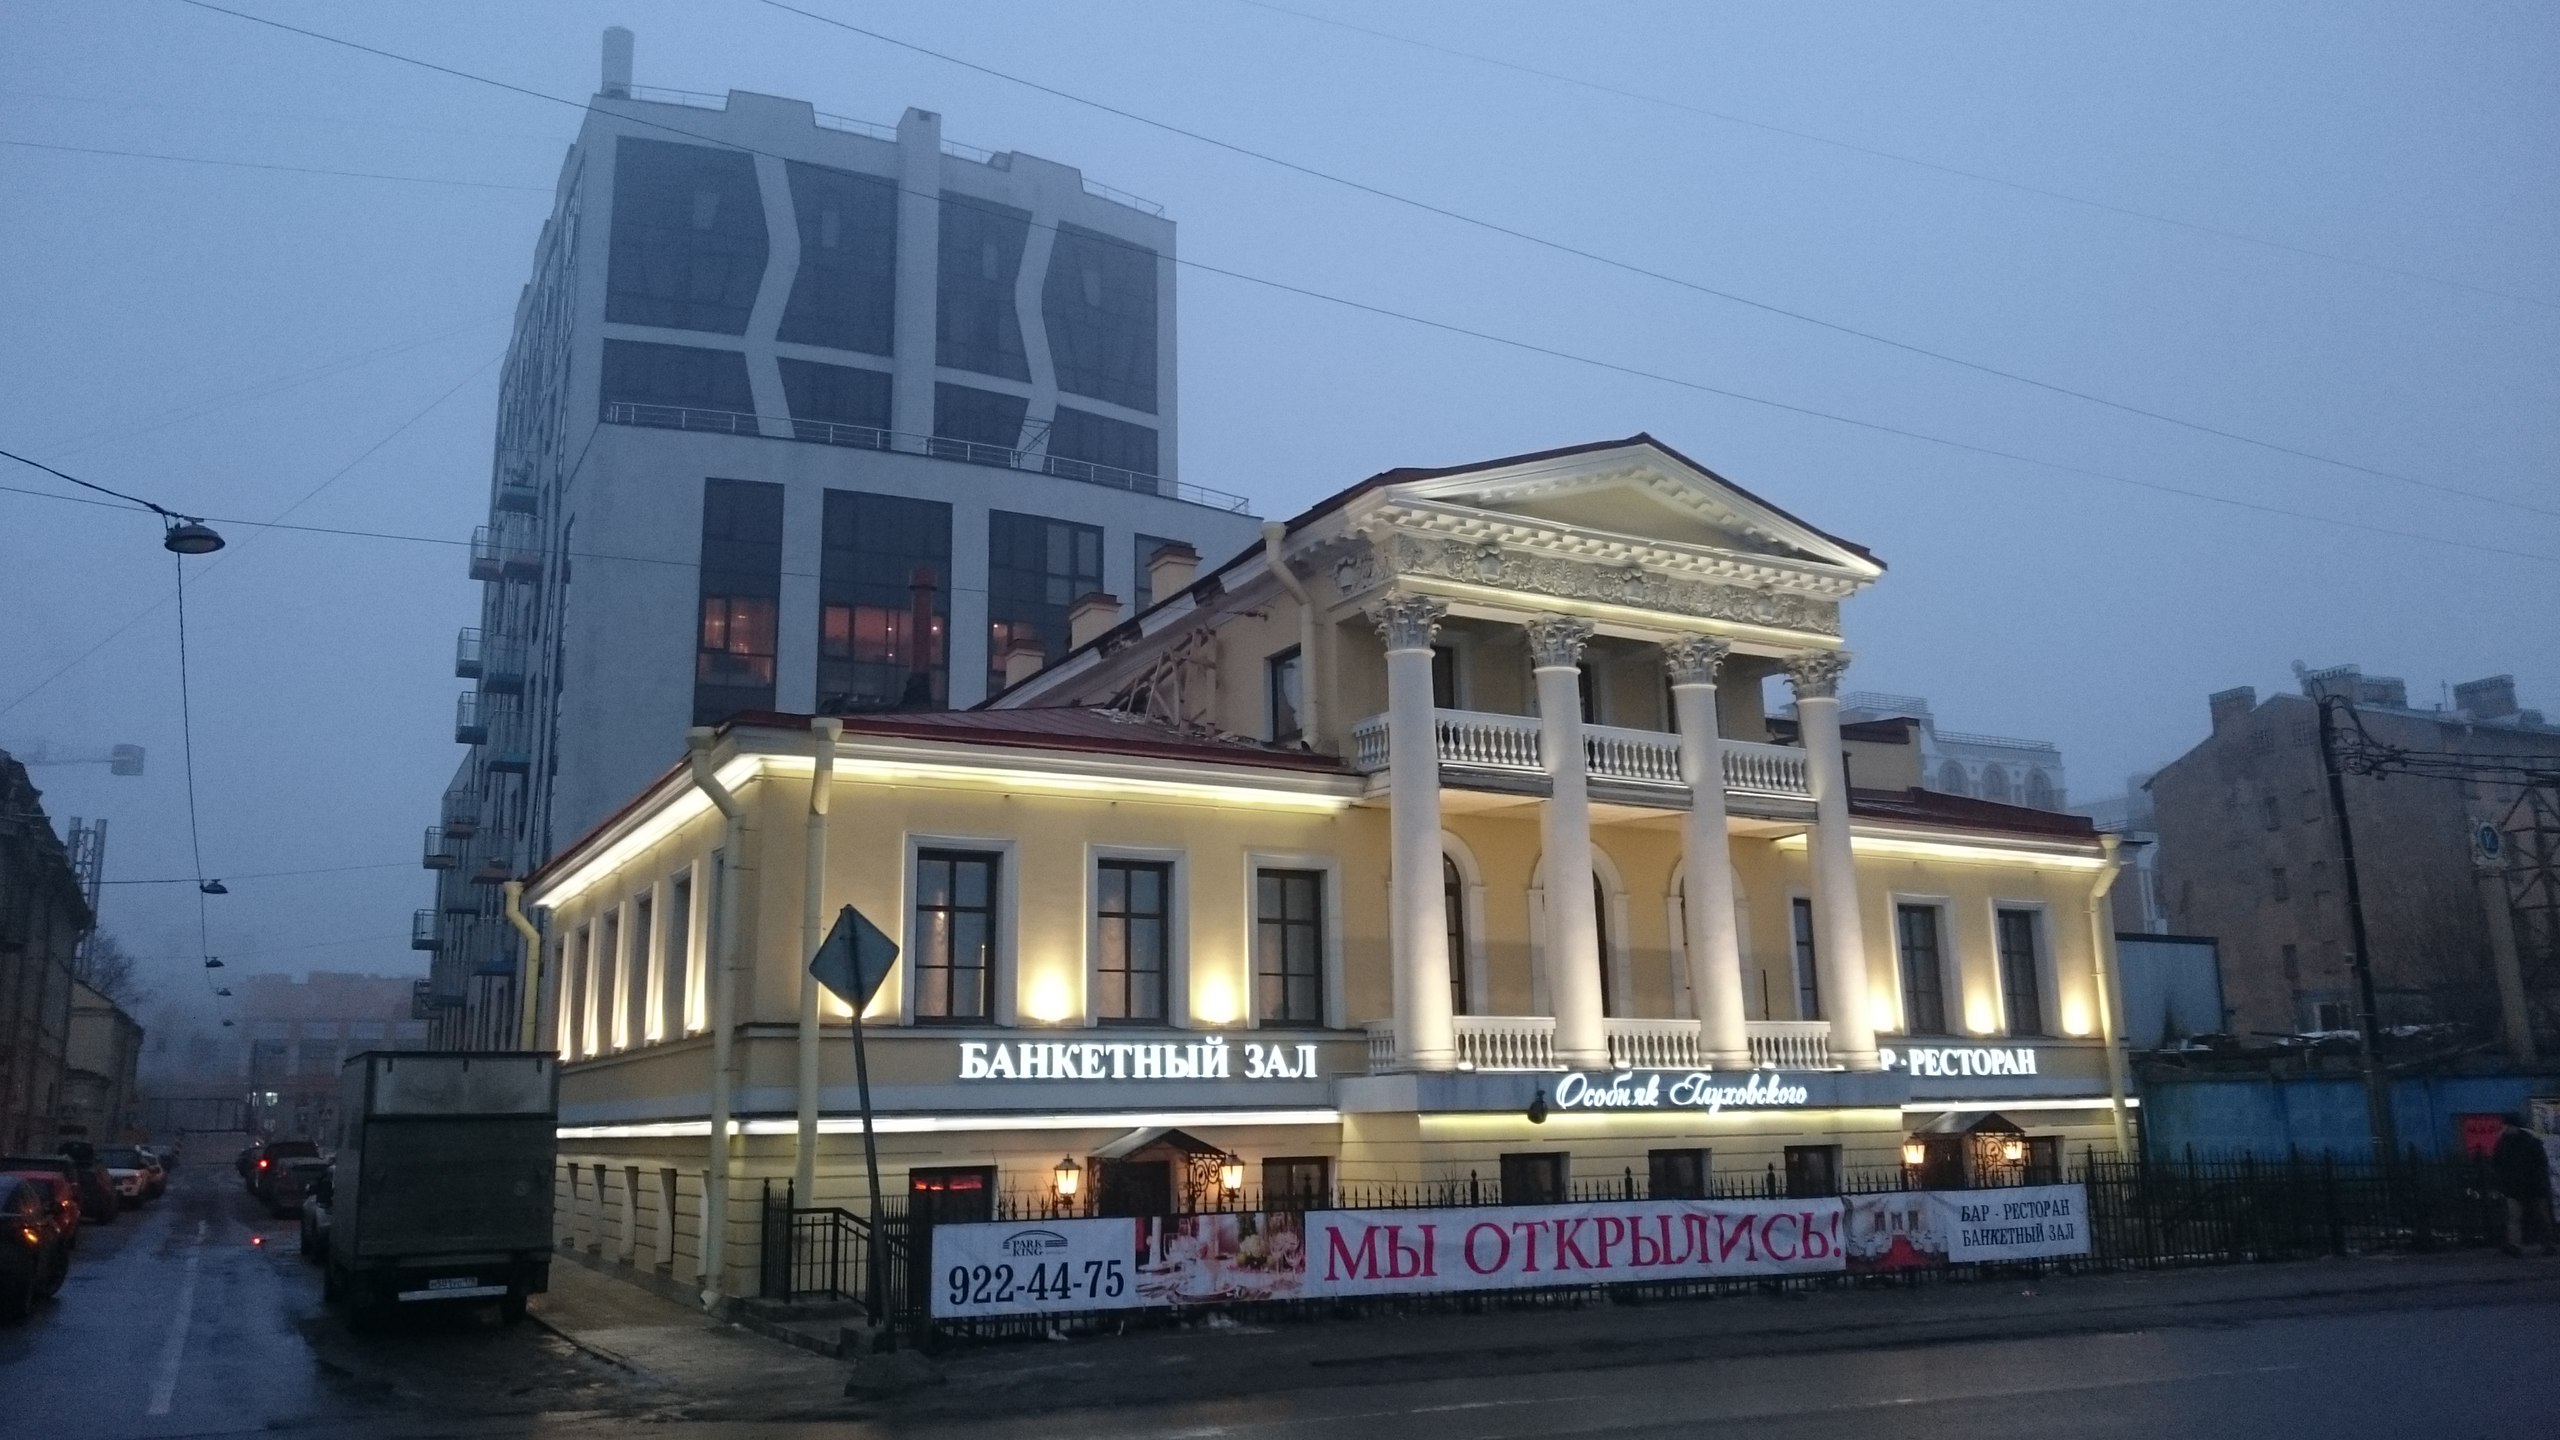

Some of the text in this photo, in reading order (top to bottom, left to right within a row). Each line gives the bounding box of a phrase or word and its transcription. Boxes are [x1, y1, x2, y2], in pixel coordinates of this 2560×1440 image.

[959, 1036, 1318, 1079] БАНКЕТНЫЙ ЗАЛ
[1908, 1048, 2037, 1076] РЕСТОРАН
[1556, 1071, 1808, 1114] Особняк Глуховского
[1961, 1199, 2070, 1222] БАР РЕСТОРАН
[1012, 1239, 1043, 1249] PARK
[1324, 1211, 1843, 1281] МЫ ОТКРЫЛИСЬ!
[1962, 1223, 2075, 1247] БАНКЕТНЫЙ ЗАЛ
[1012, 1248, 1043, 1257] KING
[949, 1259, 1124, 1305] 922-44-75
